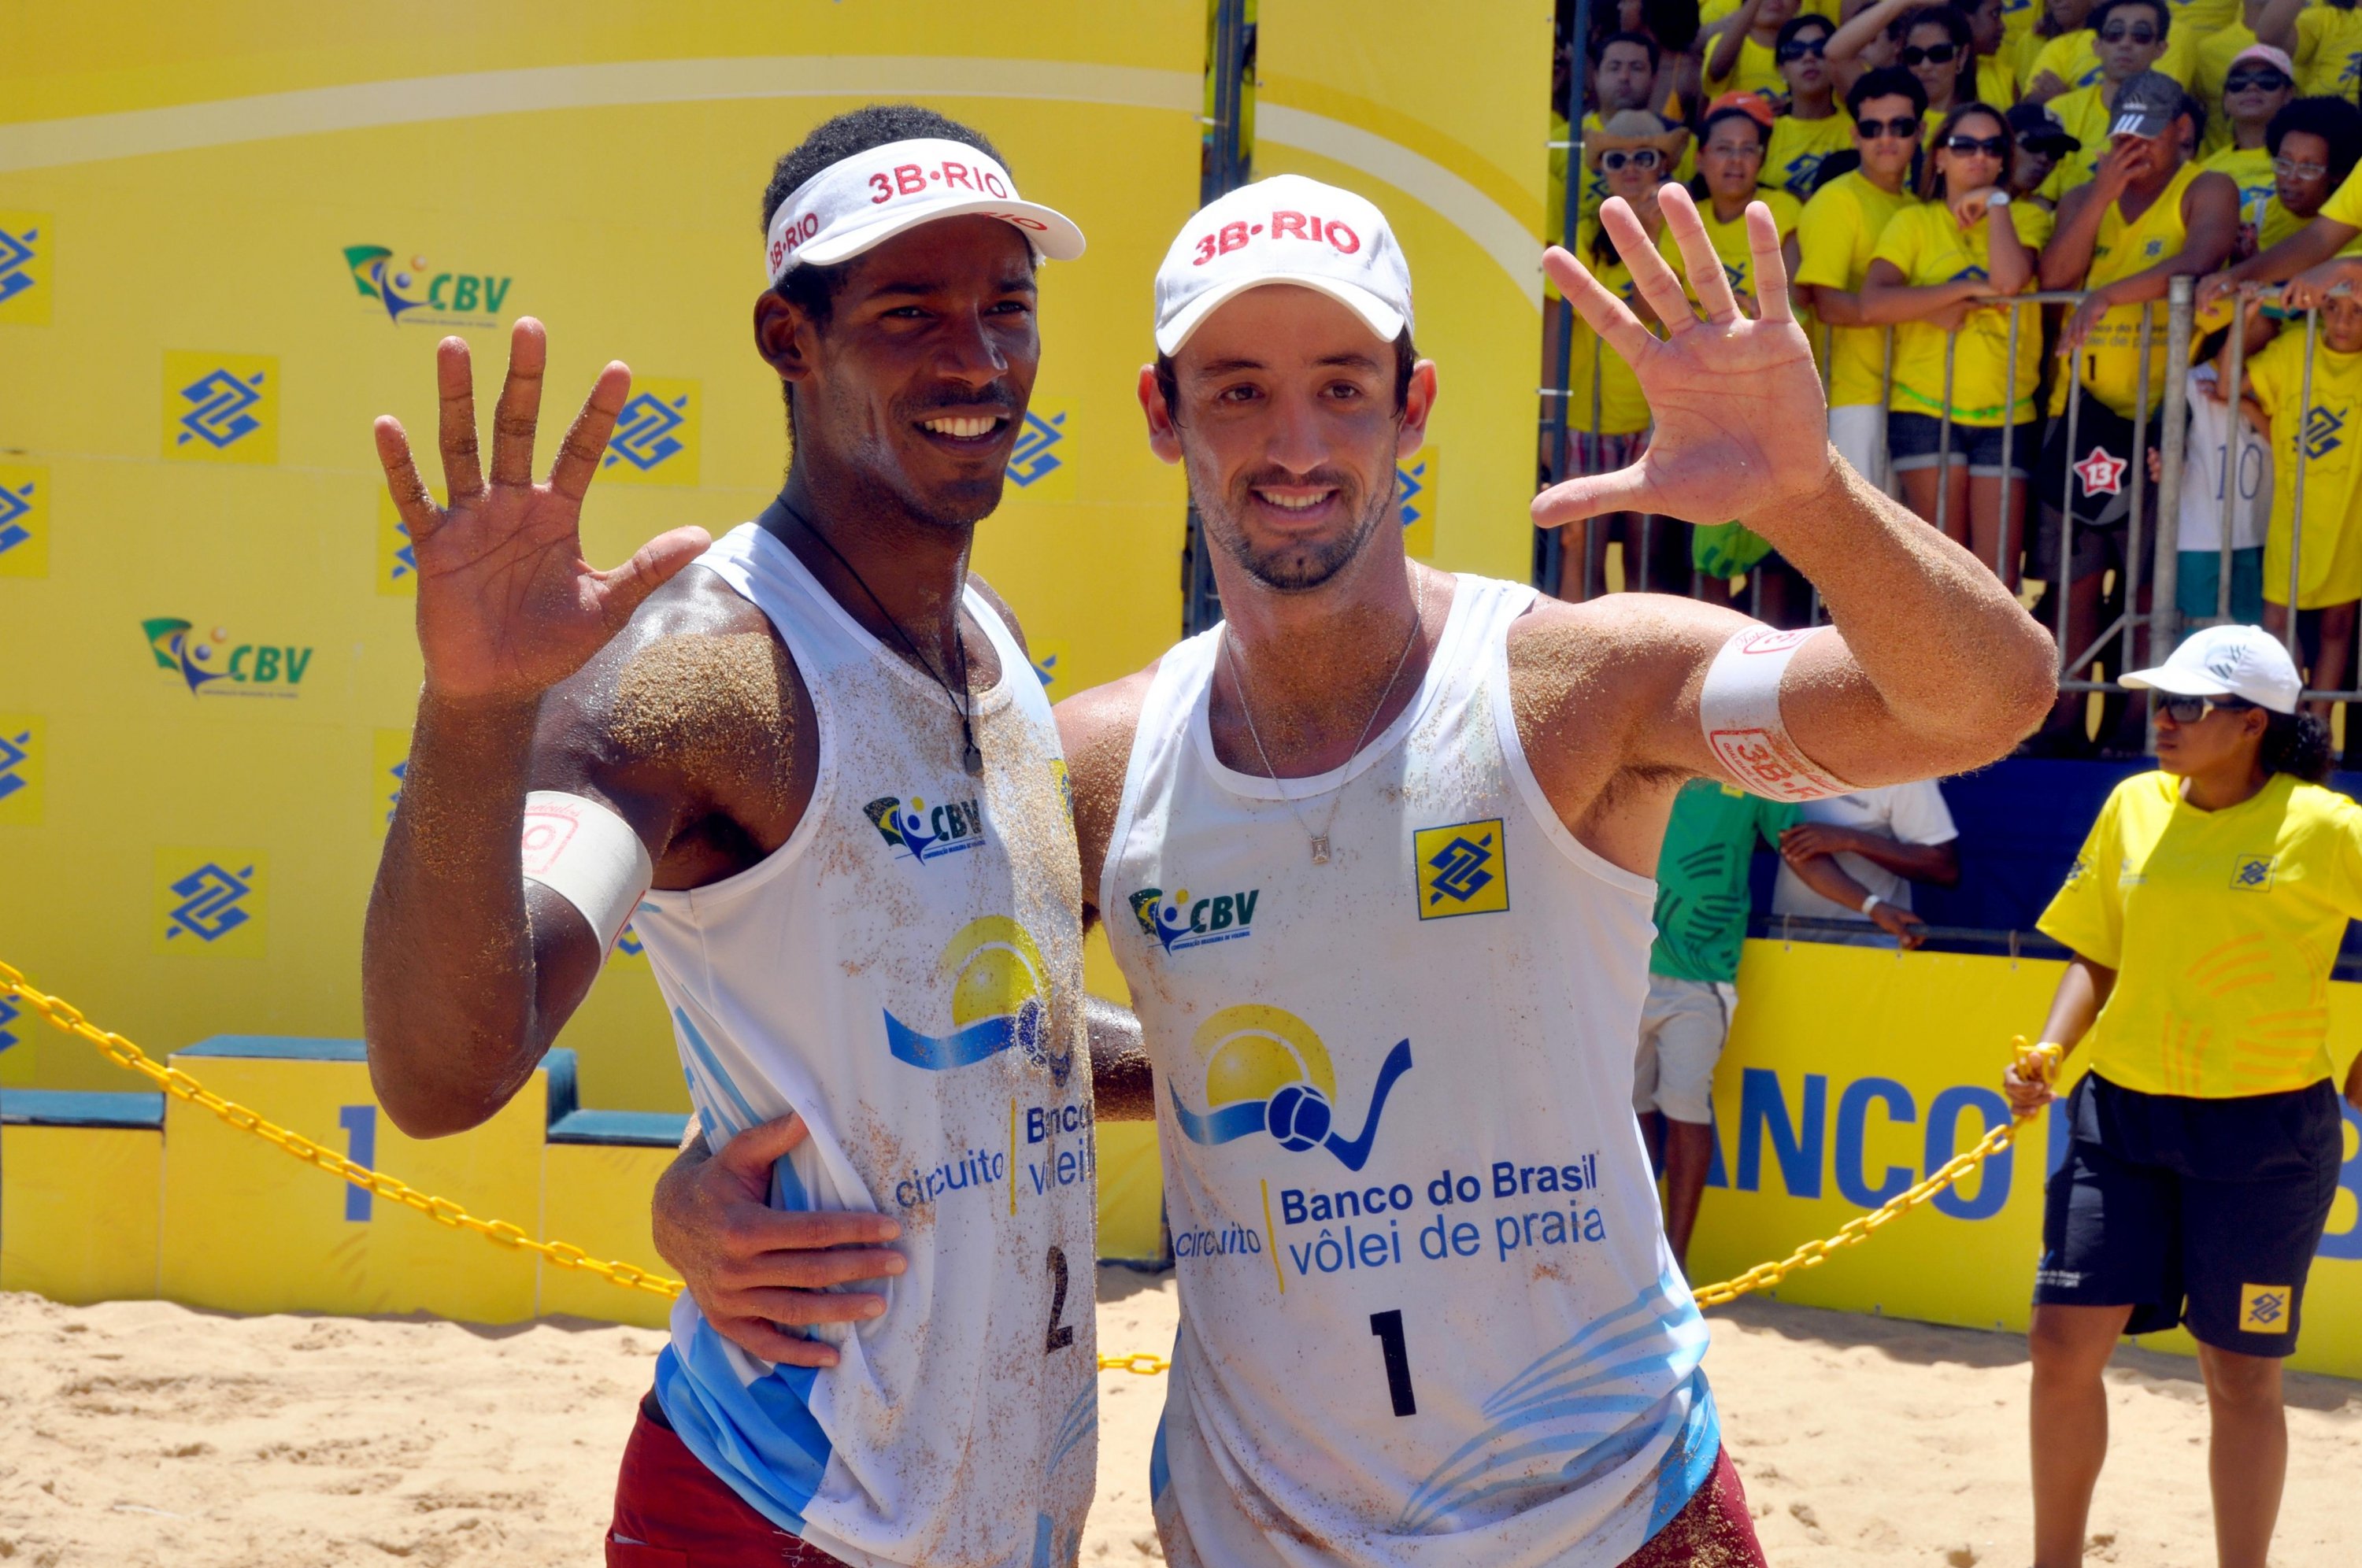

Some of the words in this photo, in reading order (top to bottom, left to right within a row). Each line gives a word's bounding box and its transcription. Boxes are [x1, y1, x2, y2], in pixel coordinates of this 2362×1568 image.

[429, 273, 511, 313] CBV
[2086, 462, 2112, 486] 13
[2216, 443, 2264, 501] 10
[228, 645, 313, 683] CBV
[931, 800, 982, 841] CBV
[1190, 889, 1260, 934] CBV
[339, 1105, 376, 1222] 1
[895, 1148, 1004, 1209] circuito
[1280, 1182, 1413, 1225] Banco
[1427, 1170, 1482, 1207] do
[1491, 1153, 1597, 1200] Brasil
[1175, 1221, 1261, 1257] circuito
[1288, 1219, 1402, 1276] vôlei
[1419, 1213, 1481, 1261] de
[1495, 1199, 1607, 1263] praia
[1046, 1246, 1073, 1354] 2
[1369, 1309, 1417, 1418] 1
